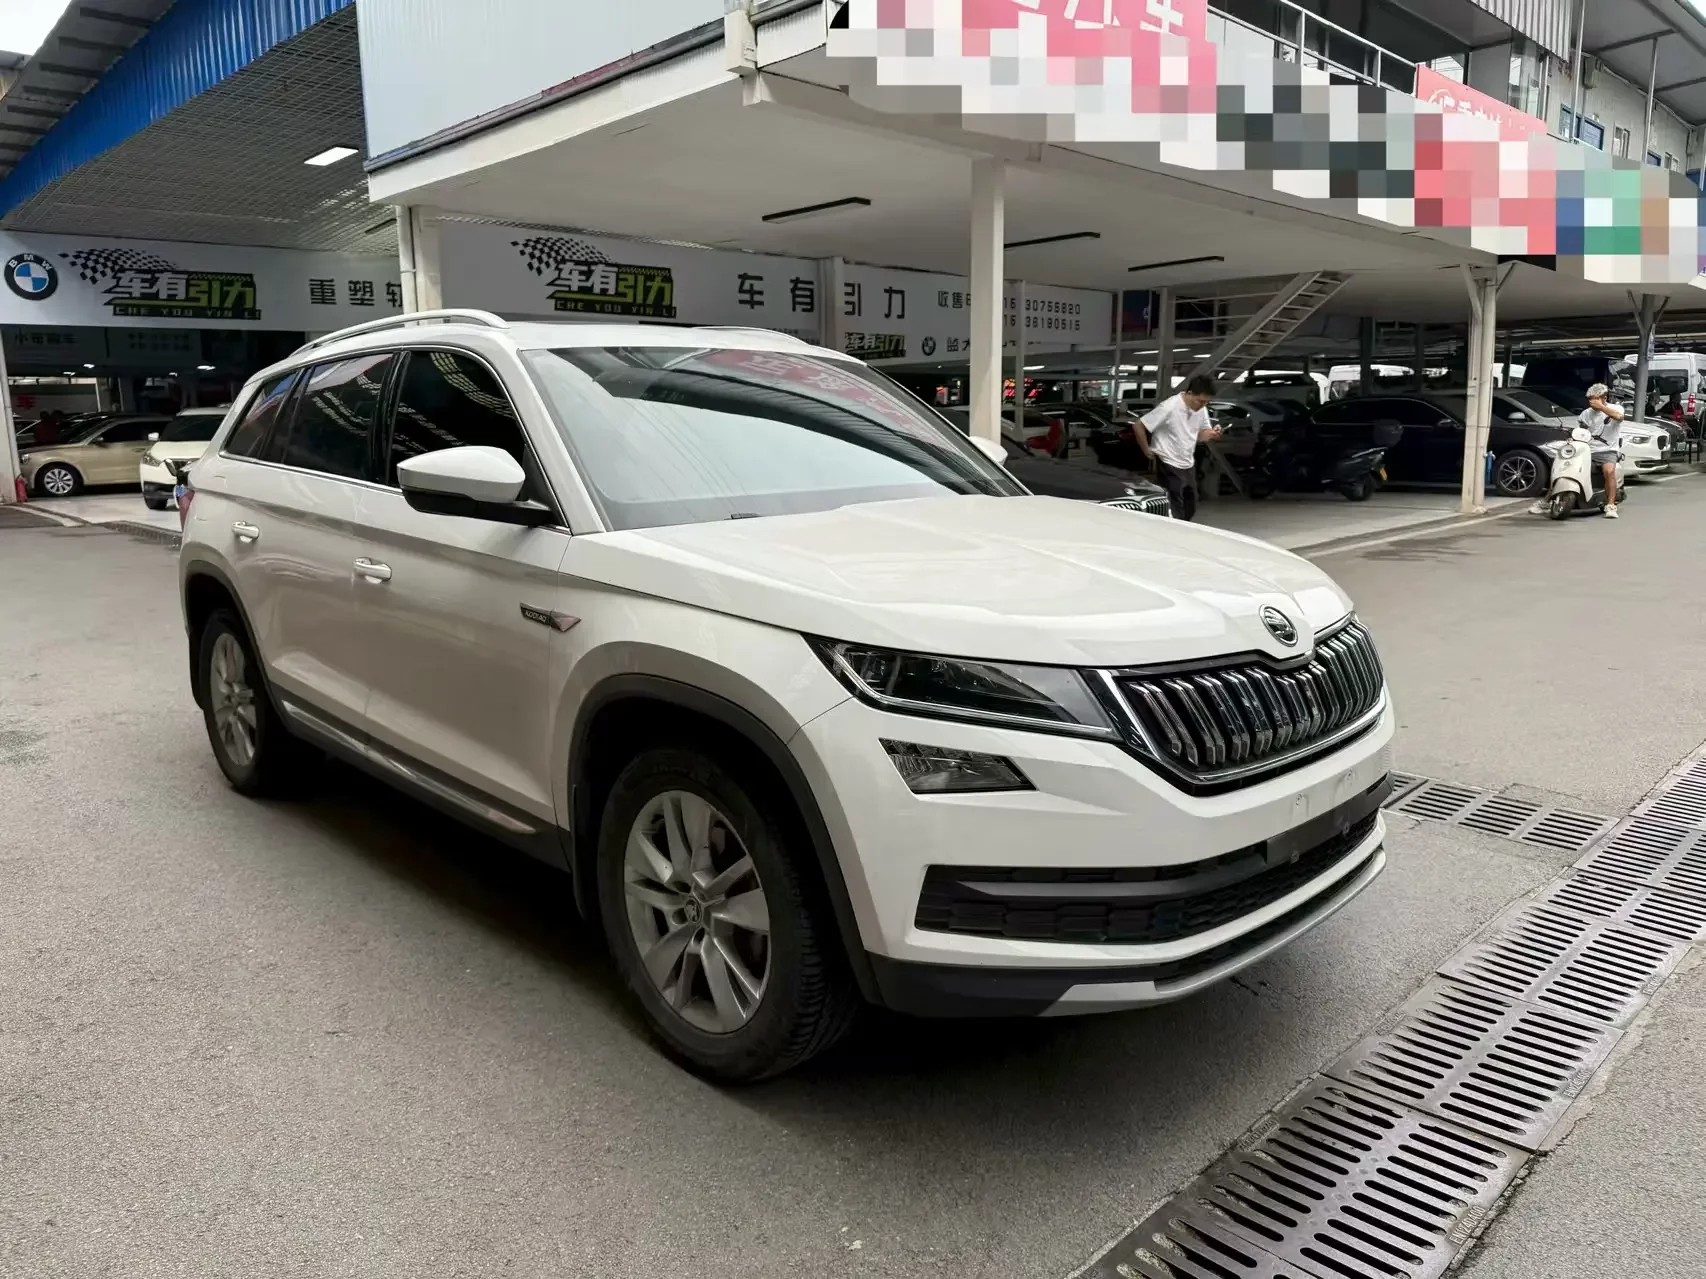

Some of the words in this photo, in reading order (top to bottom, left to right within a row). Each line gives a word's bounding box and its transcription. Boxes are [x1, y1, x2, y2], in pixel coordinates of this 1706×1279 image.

[112, 270, 255, 308] 车有引力
[554, 262, 672, 306] 车有引力
[737, 272, 906, 320] 车有引力
[161, 307, 193, 317] YOU
[206, 308, 233, 318] YIN
[595, 303, 622, 313] YOU
[632, 305, 655, 315] YIN
[849, 333, 904, 351] 车有引力
